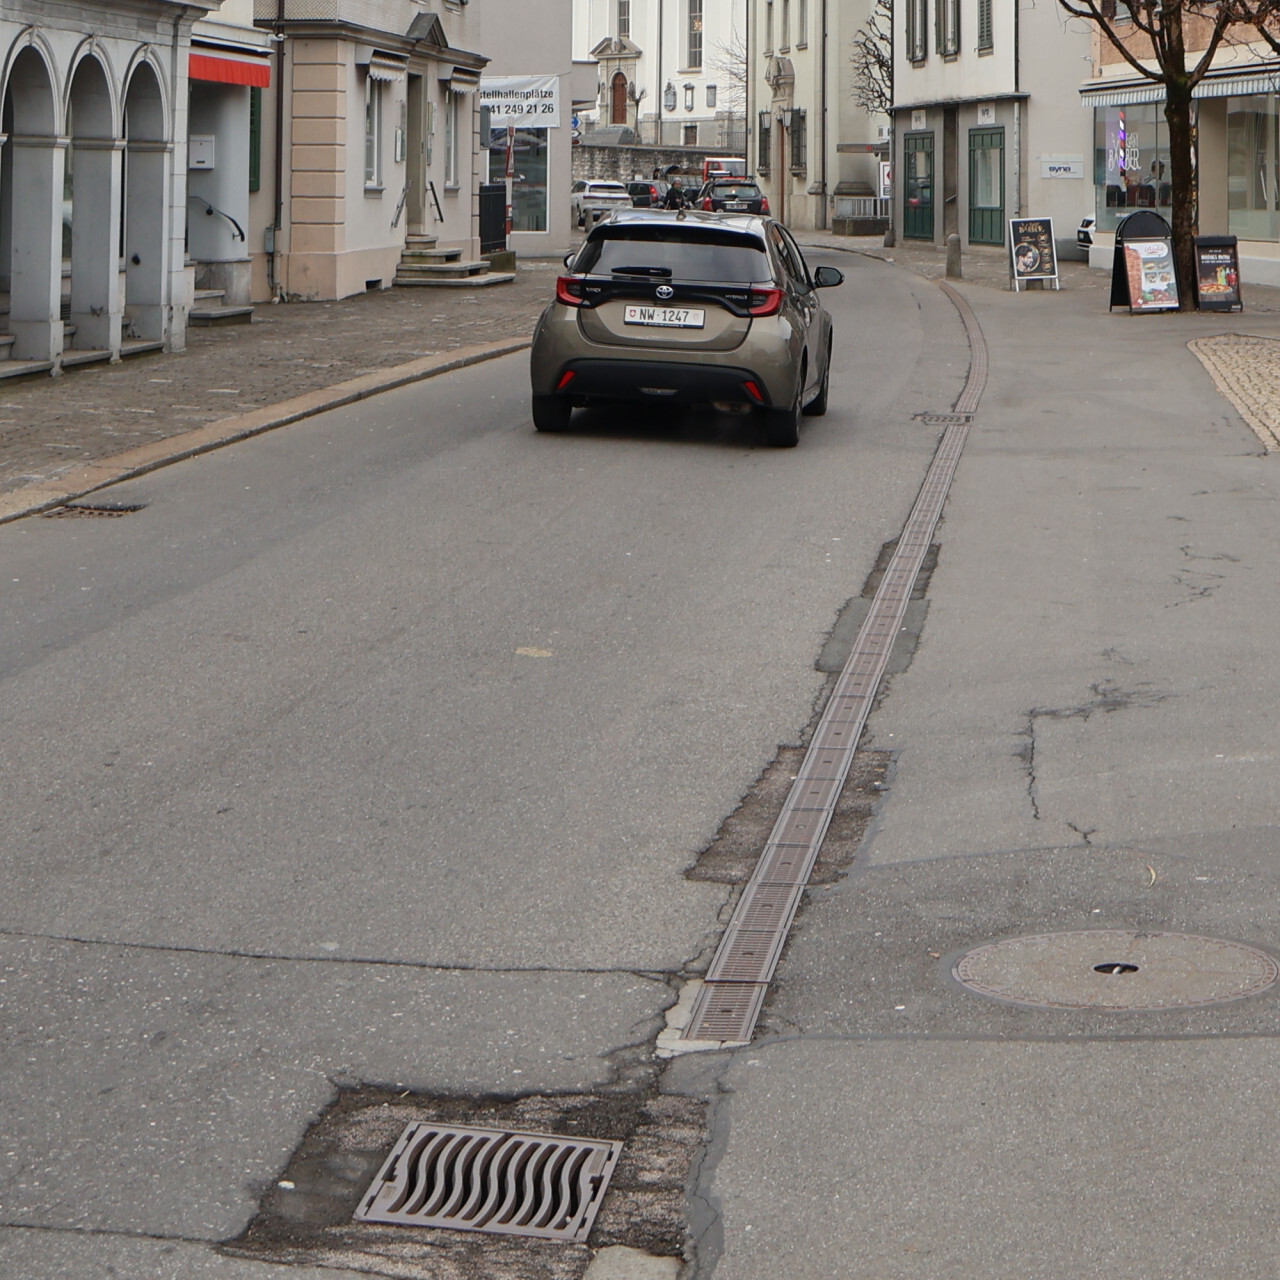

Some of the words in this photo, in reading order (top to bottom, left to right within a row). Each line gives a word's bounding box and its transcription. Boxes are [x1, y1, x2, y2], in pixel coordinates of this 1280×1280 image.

[489, 104, 501, 115] 41
[504, 104, 524, 115] 249
[526, 104, 538, 114] 21
[541, 103, 554, 114] 26
